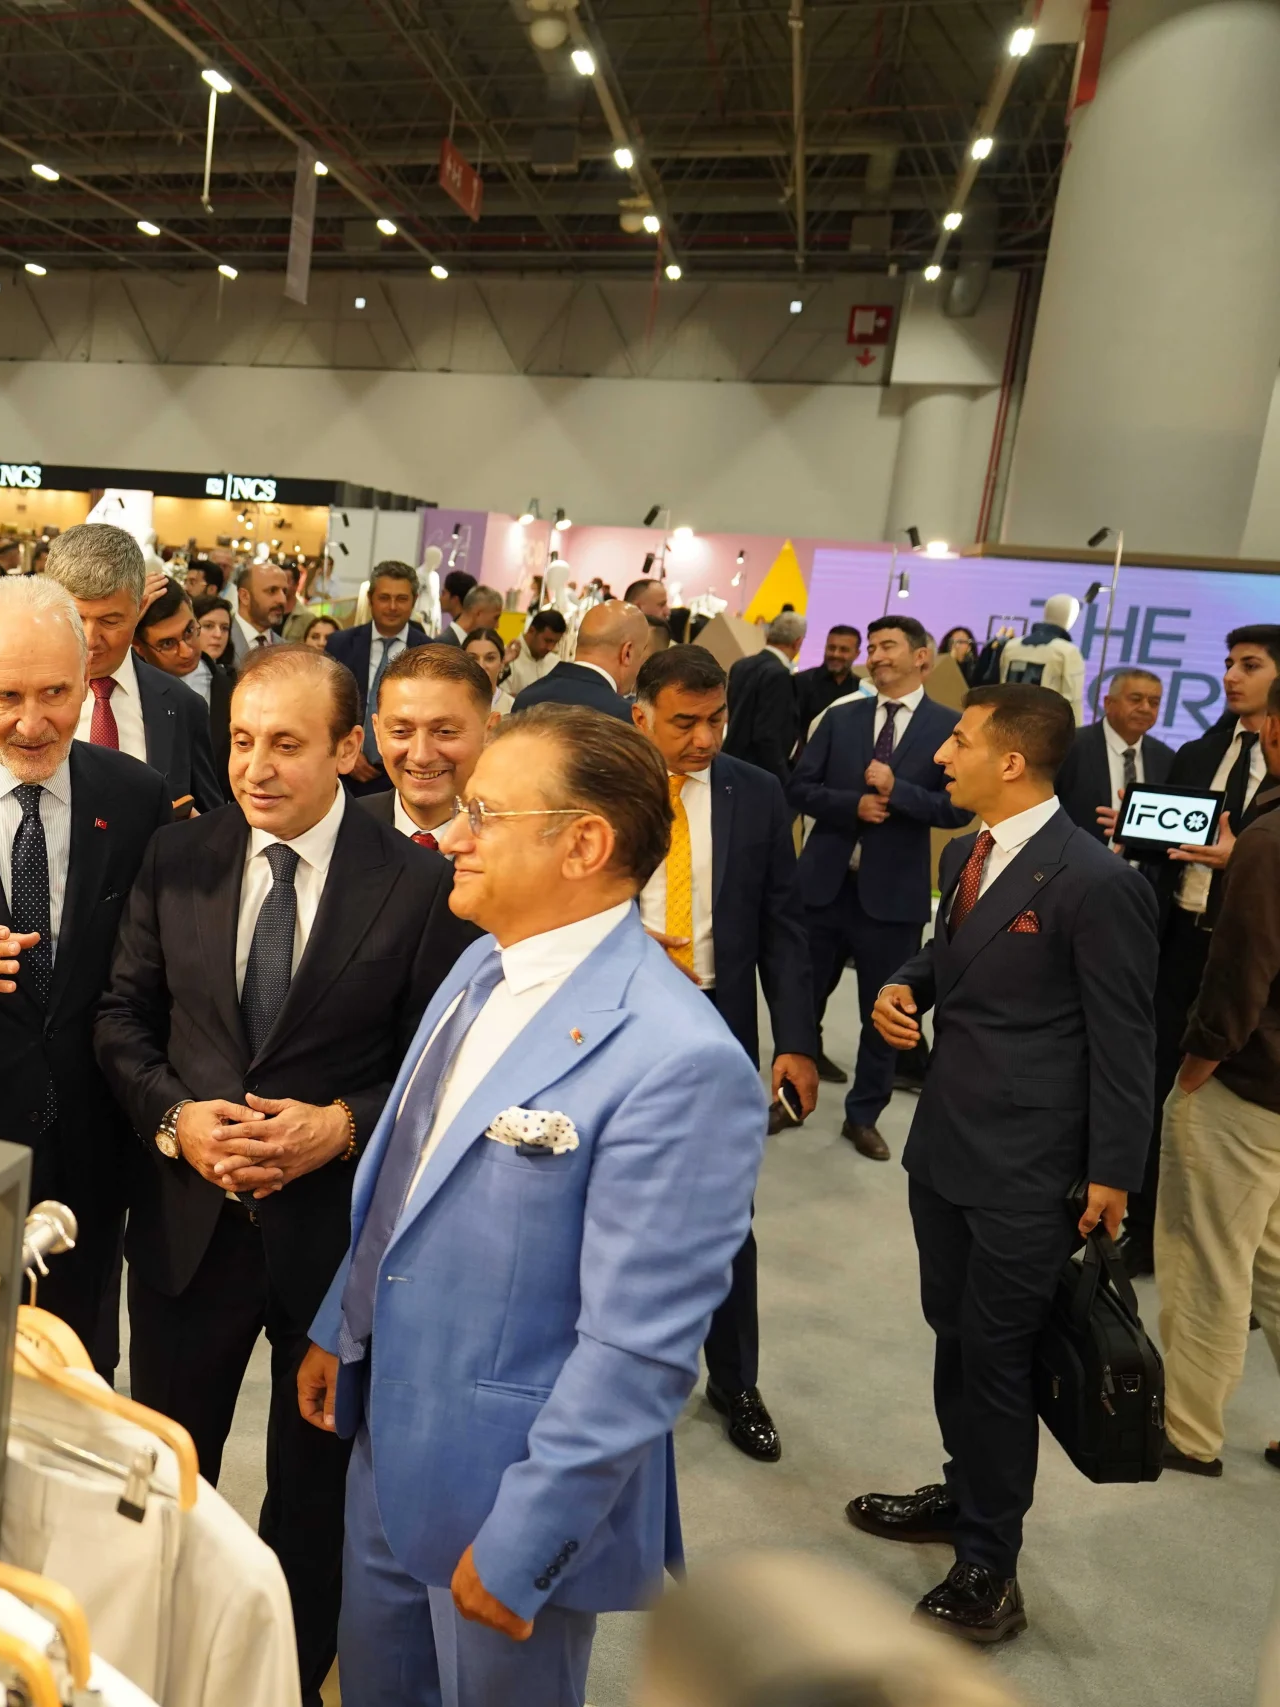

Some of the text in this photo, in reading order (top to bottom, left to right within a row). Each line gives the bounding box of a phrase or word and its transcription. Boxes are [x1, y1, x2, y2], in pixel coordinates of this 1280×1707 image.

[0, 464, 42, 489] NCS
[231, 477, 277, 502] NCS
[1030, 598, 1192, 668] HE
